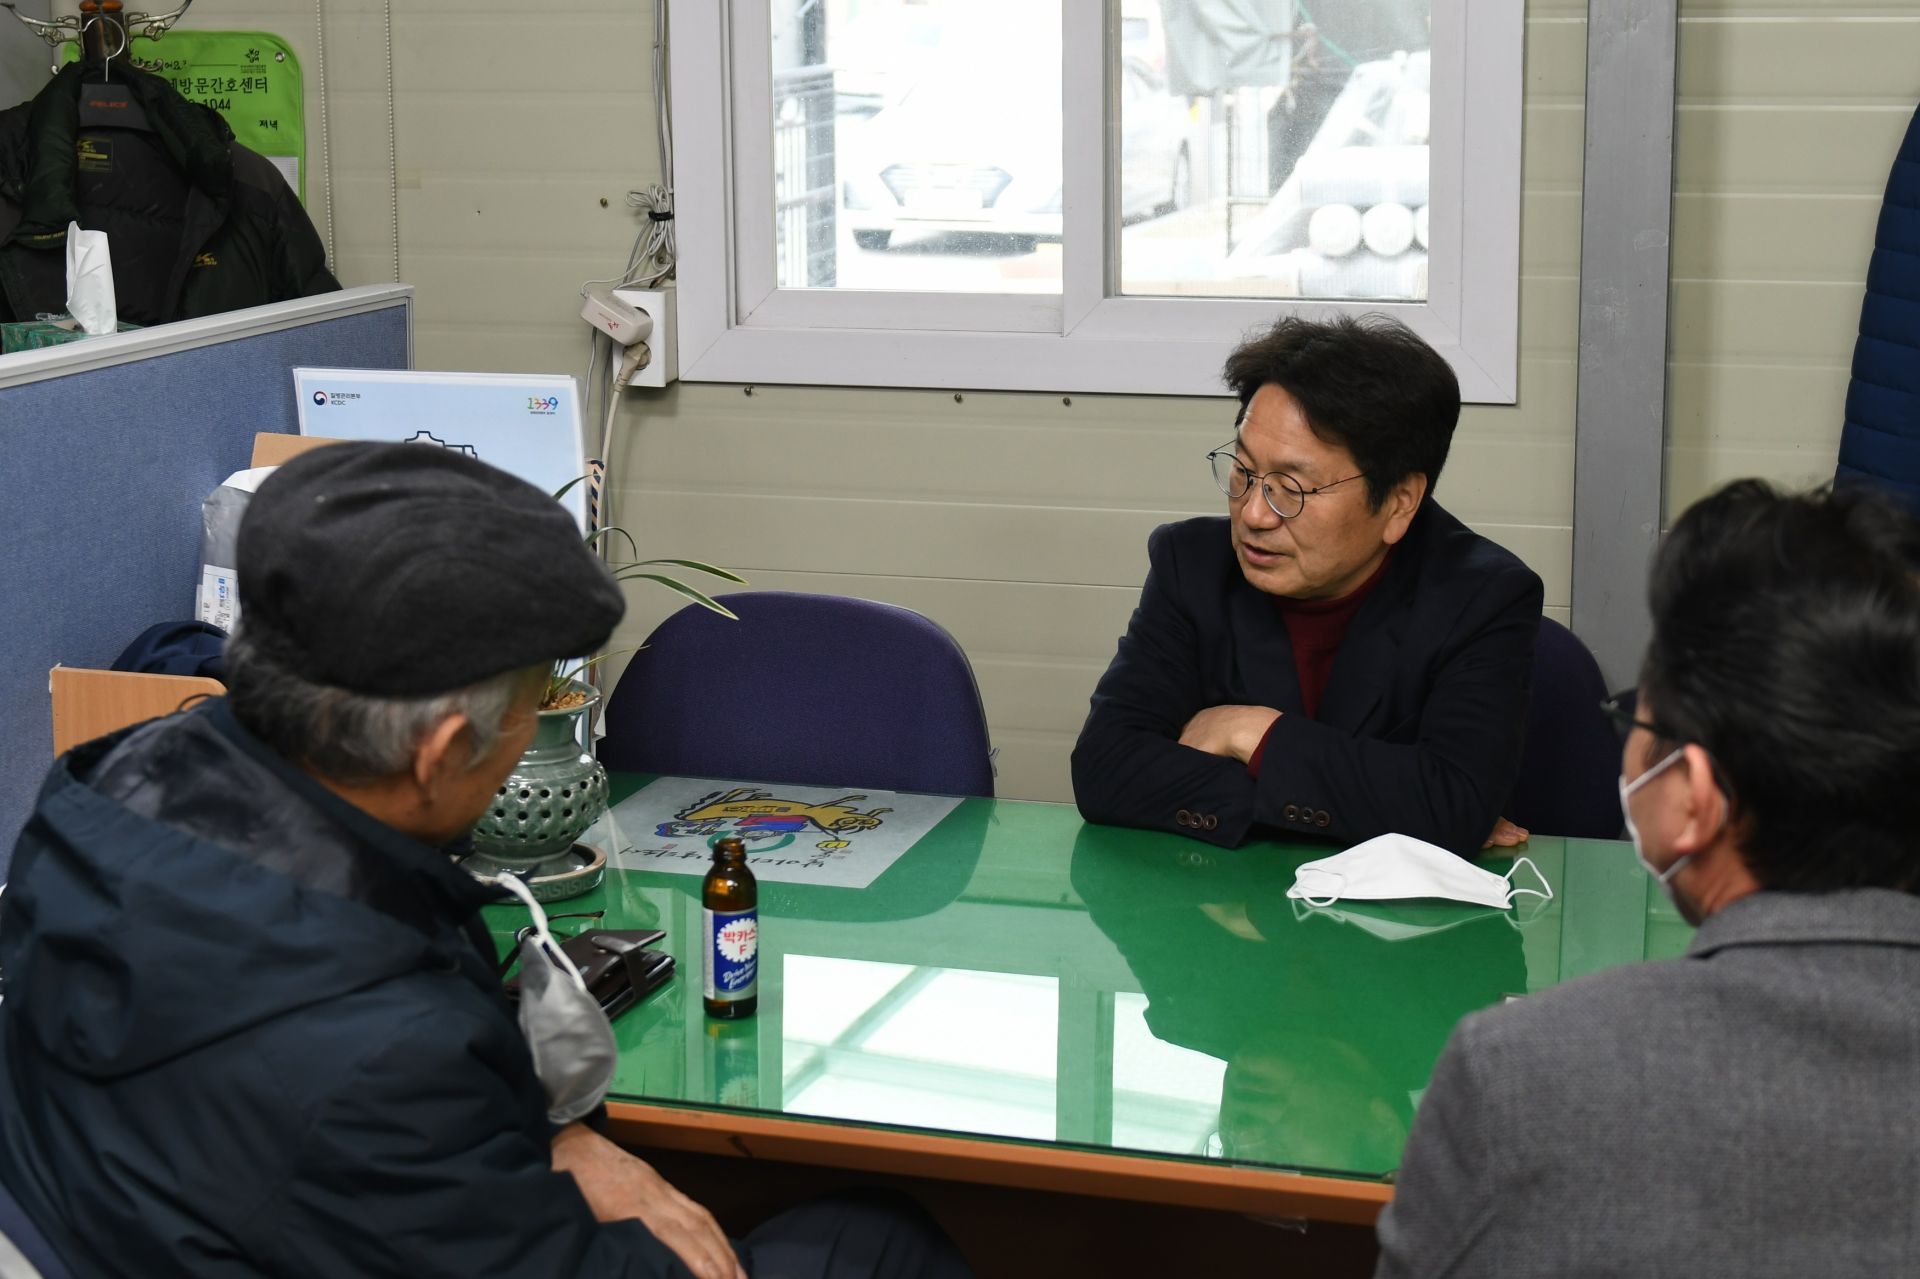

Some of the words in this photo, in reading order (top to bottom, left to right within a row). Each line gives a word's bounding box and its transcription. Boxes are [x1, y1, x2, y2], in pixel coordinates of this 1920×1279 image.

[260, 120, 278, 130] 저녁
[527, 396, 559, 410] 1339
[723, 928, 756, 943] 박카스
[739, 944, 747, 955] F
